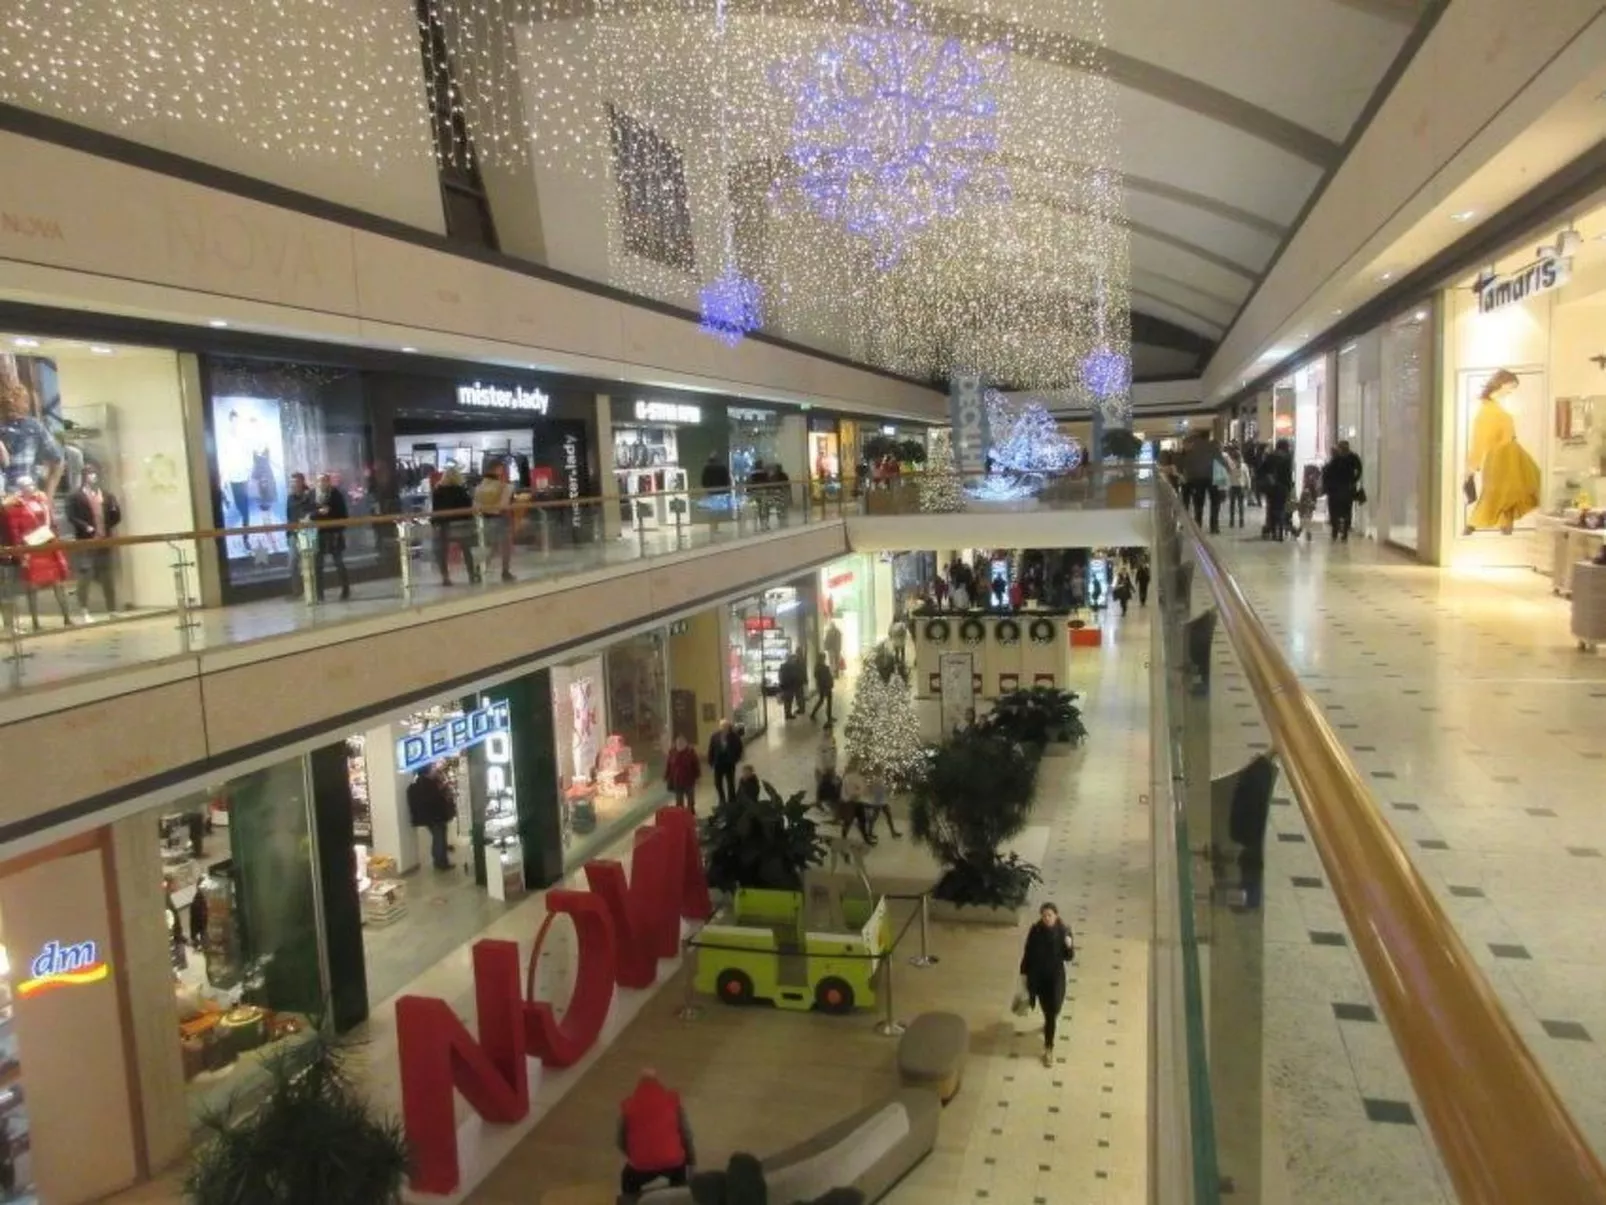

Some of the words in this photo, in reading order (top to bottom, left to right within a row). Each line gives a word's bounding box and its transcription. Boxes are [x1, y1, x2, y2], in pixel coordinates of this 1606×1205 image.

[403, 699, 509, 767] DEPOT
[31, 939, 96, 980] dm
[396, 806, 712, 1196] NOVA
